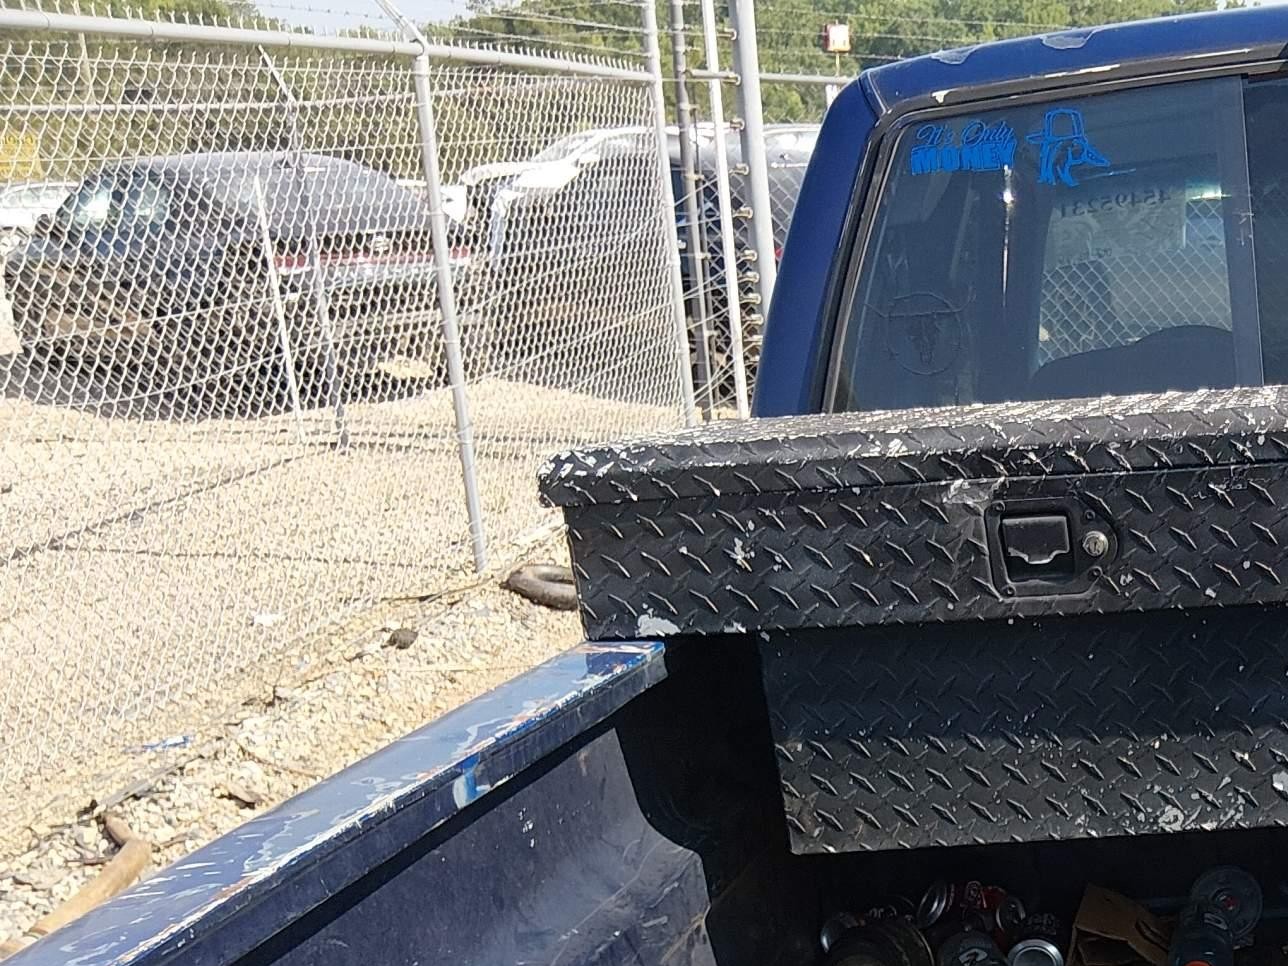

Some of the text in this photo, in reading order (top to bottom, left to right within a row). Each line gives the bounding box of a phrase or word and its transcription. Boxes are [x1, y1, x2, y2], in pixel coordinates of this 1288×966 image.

[916, 119, 1016, 149] It's Only
[911, 142, 1017, 176] MONEY
